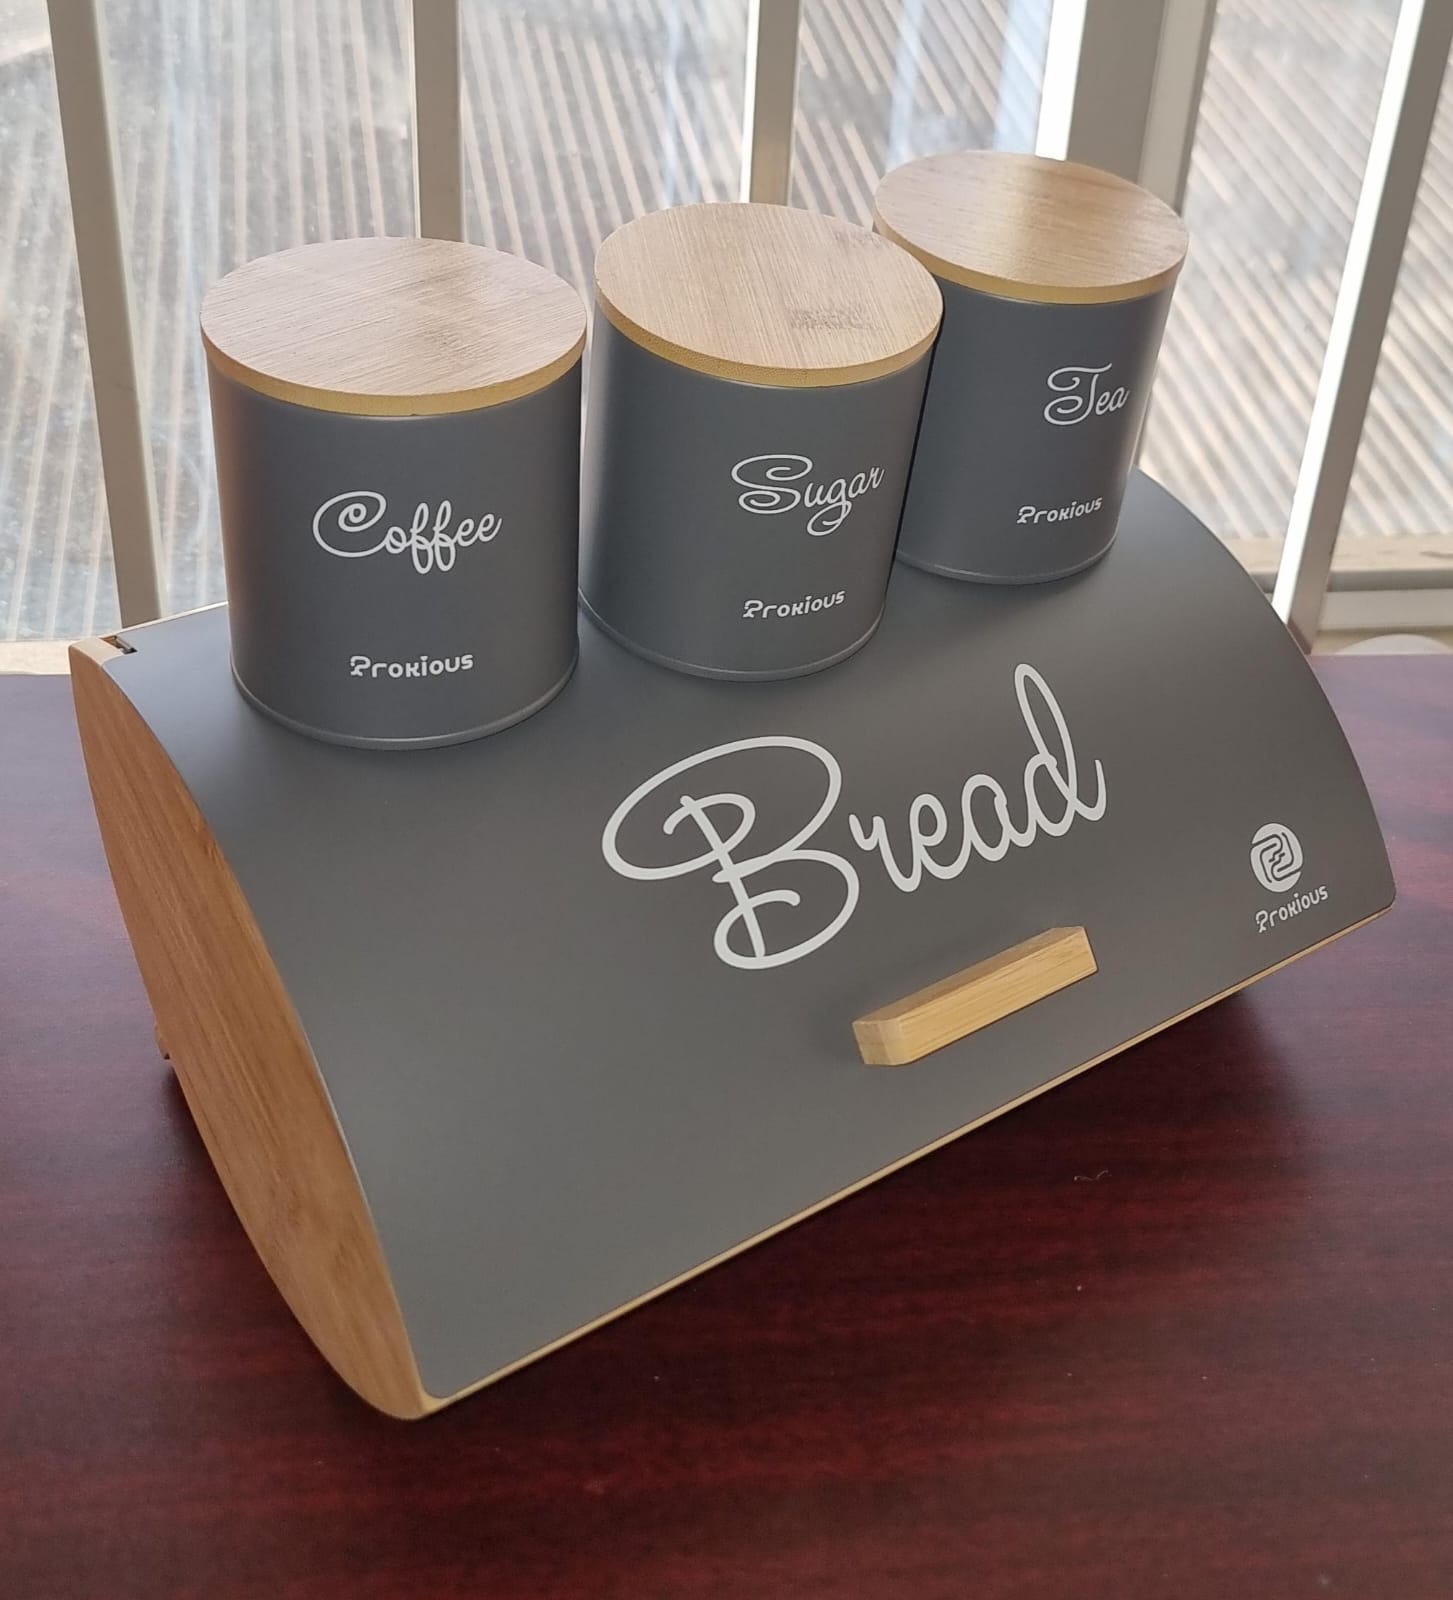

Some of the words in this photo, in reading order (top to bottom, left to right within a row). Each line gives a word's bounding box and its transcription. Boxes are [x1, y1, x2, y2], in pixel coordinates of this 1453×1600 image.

[1042, 362, 1130, 427] Tea
[312, 490, 503, 575] Coffee
[730, 453, 886, 537] Sugar
[601, 662, 1108, 971] Bread
